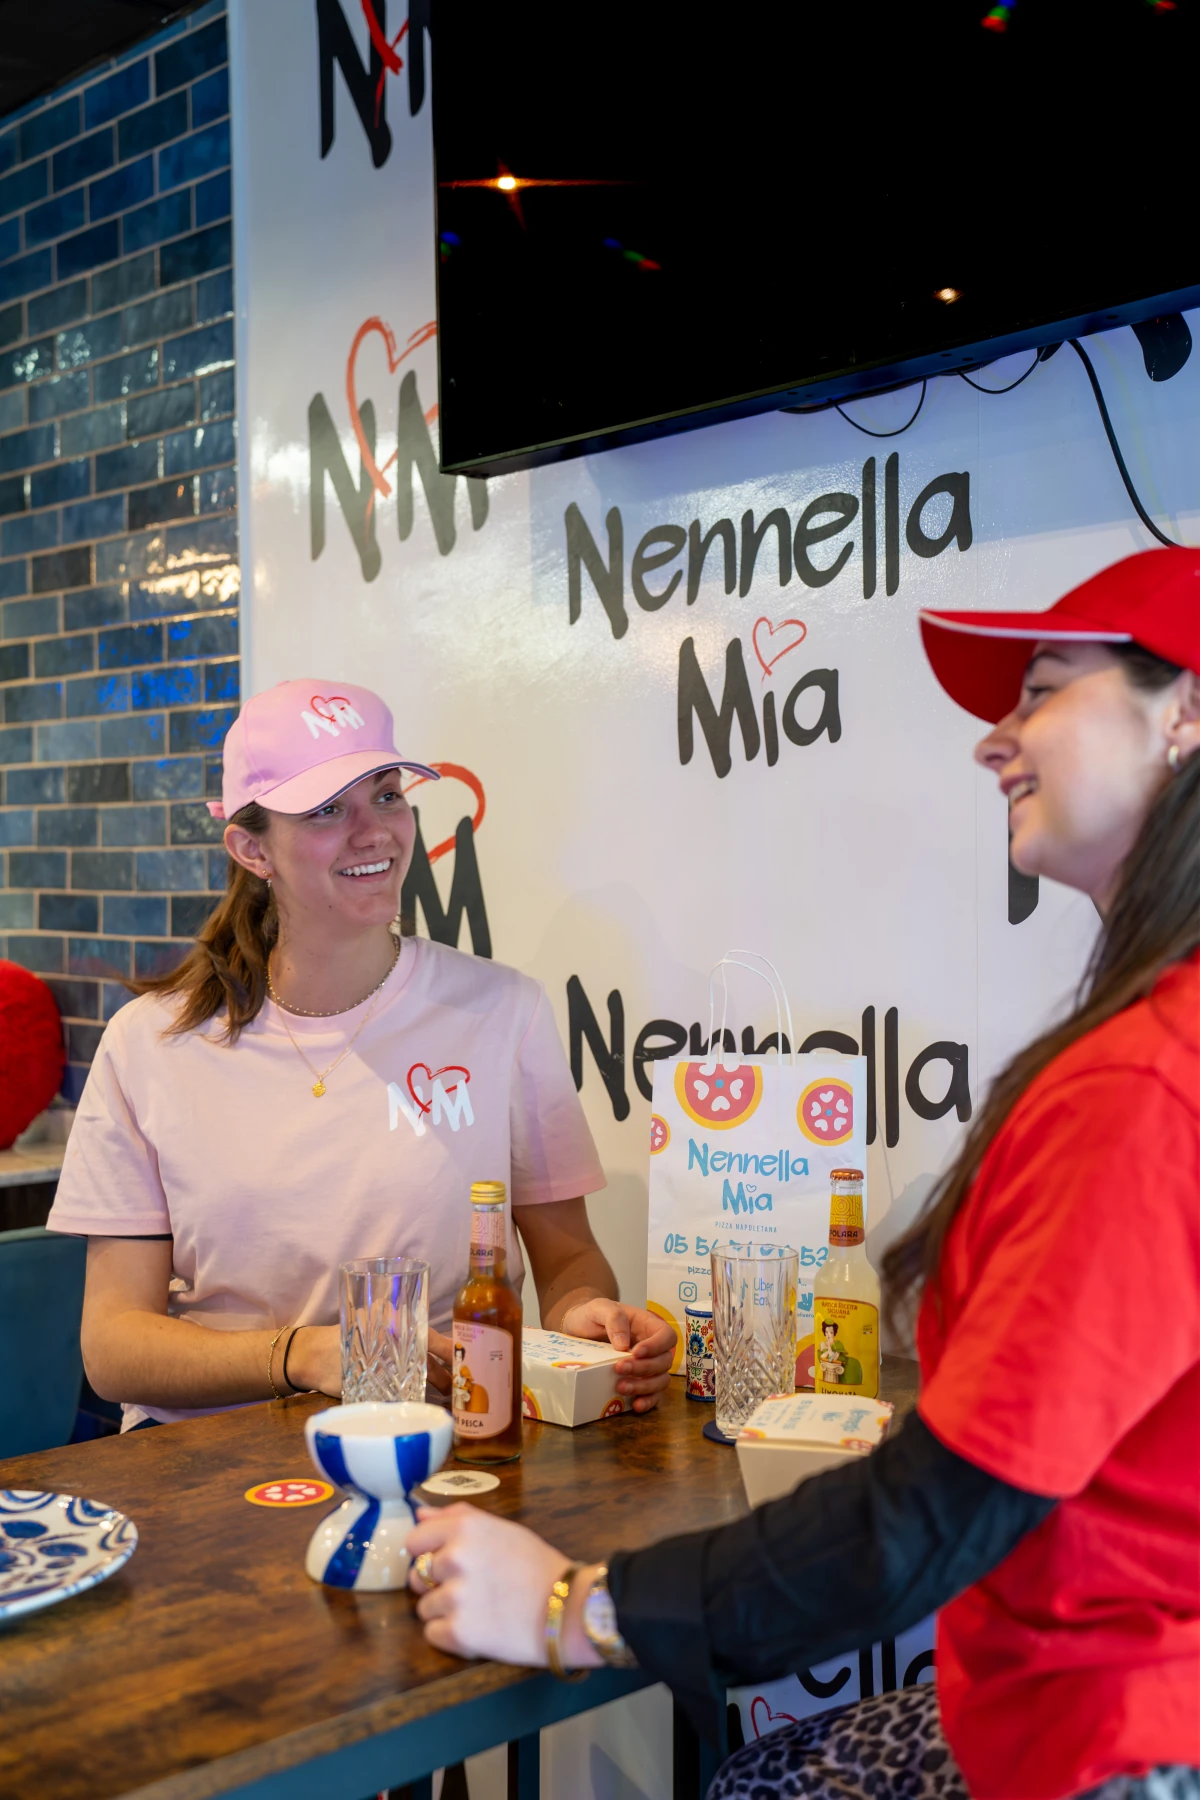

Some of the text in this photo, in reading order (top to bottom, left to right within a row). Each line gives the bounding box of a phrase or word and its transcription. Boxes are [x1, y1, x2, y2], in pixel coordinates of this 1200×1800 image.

[564, 451, 974, 640] Nennella
[676, 617, 842, 779] Mia
[301, 703, 365, 739] NM
[400, 806, 493, 960] M
[566, 974, 972, 1148] Nella
[387, 1077, 475, 1137] NM
[688, 1138, 809, 1182] Nennella
[722, 1179, 773, 1215] Mia
[664, 1233, 689, 1254] 05
[714, 1221, 777, 1233] PIZZA NAPOLETANA
[829, 1229, 858, 1238] POLARA
[470, 1247, 493, 1257] LARA
[461, 1418, 484, 1428] PESCA
